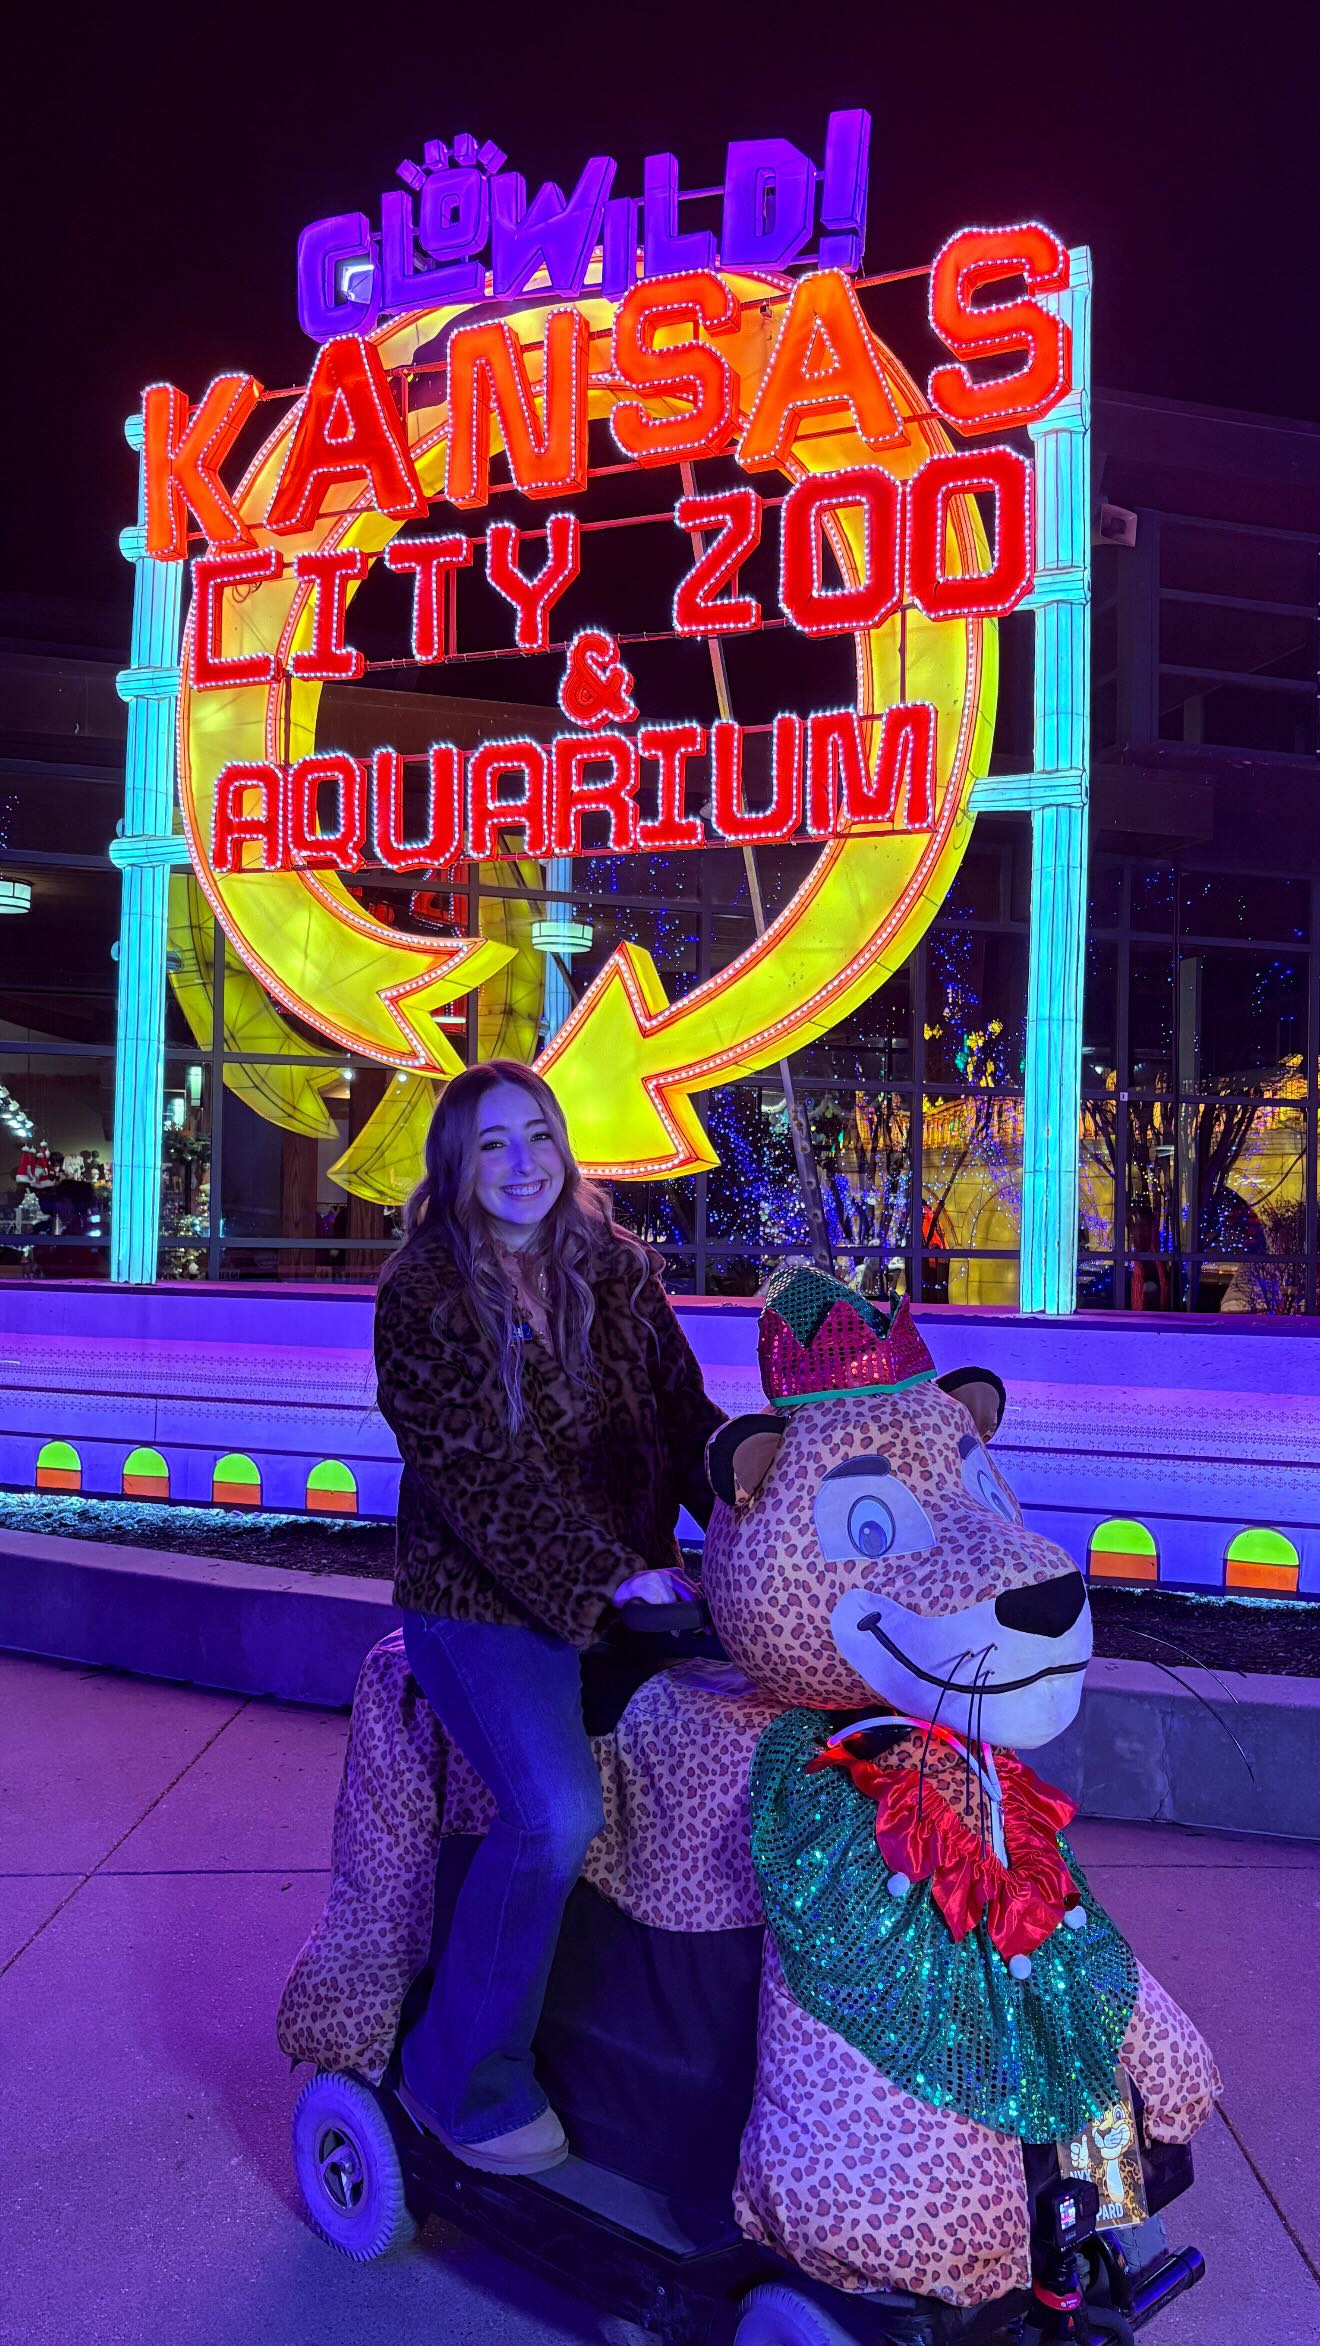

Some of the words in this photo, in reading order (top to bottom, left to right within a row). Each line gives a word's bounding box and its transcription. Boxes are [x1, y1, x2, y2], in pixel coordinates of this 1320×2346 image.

[141, 222, 1072, 562] KANSAS
[188, 513, 581, 692] CITY
[672, 445, 1034, 638] ZOO
[557, 627, 641, 728] &
[210, 700, 938, 874] AQUARIUM
